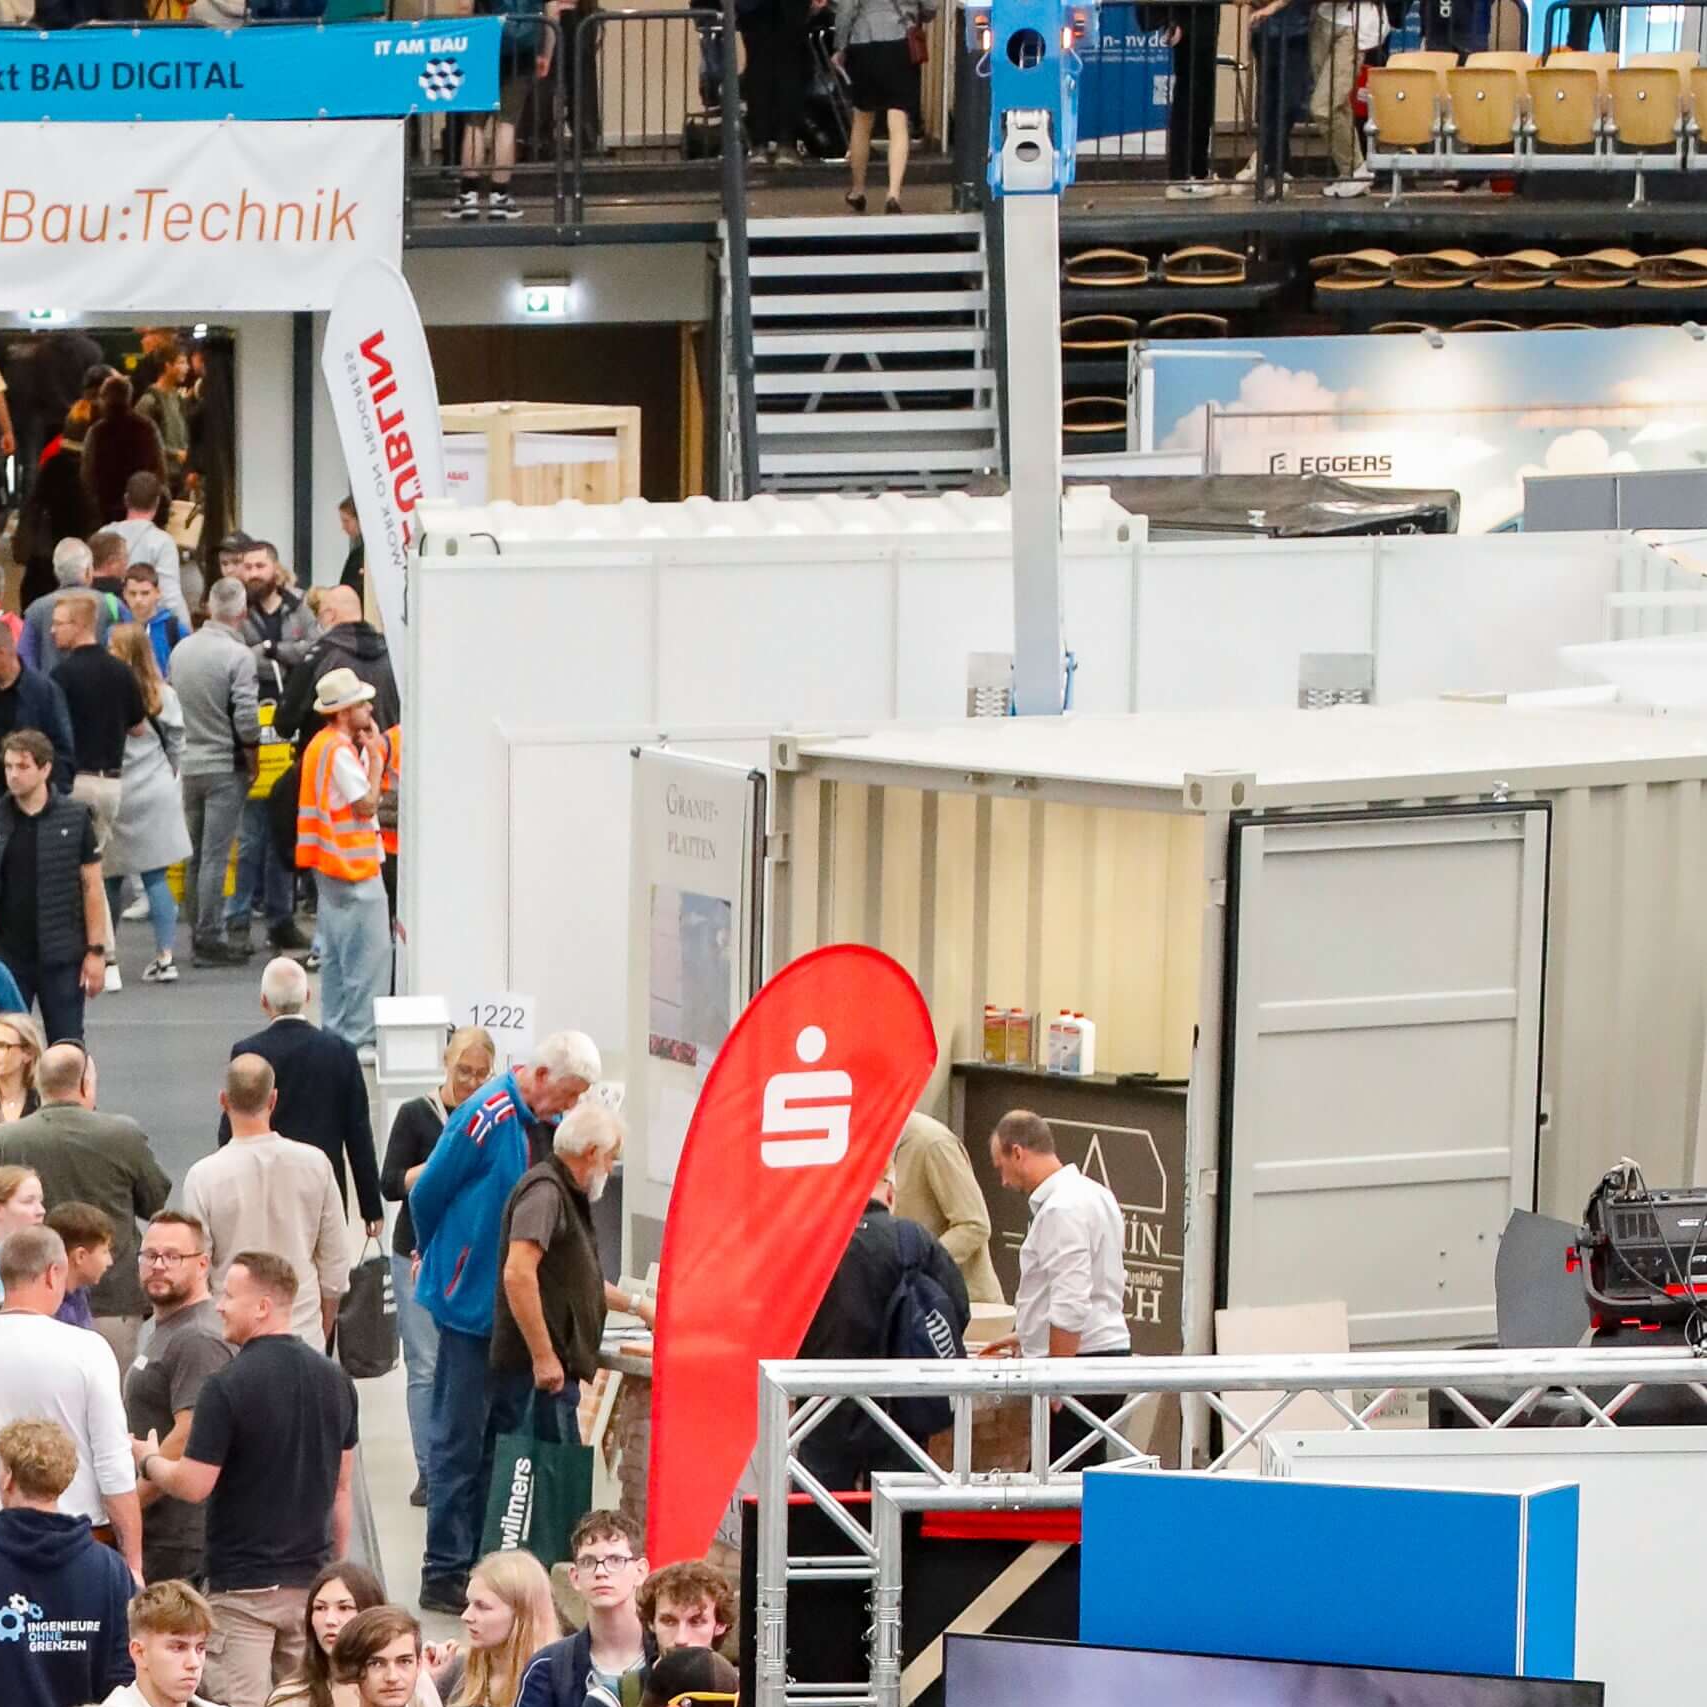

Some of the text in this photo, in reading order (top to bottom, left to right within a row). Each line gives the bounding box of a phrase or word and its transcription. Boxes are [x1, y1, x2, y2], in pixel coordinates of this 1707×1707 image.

[374, 36, 468, 57] IT AM BAU
[30, 62, 101, 92] BAU
[112, 60, 245, 91] DIGITAL
[1300, 455, 1392, 473] EGGERS
[468, 1003, 526, 1030] 1222
[499, 1457, 532, 1552] wilmers
[27, 1620, 101, 1633] INGENIEURE
[28, 1631, 63, 1642] OHNE
[29, 1640, 88, 1653] GRENZEN
